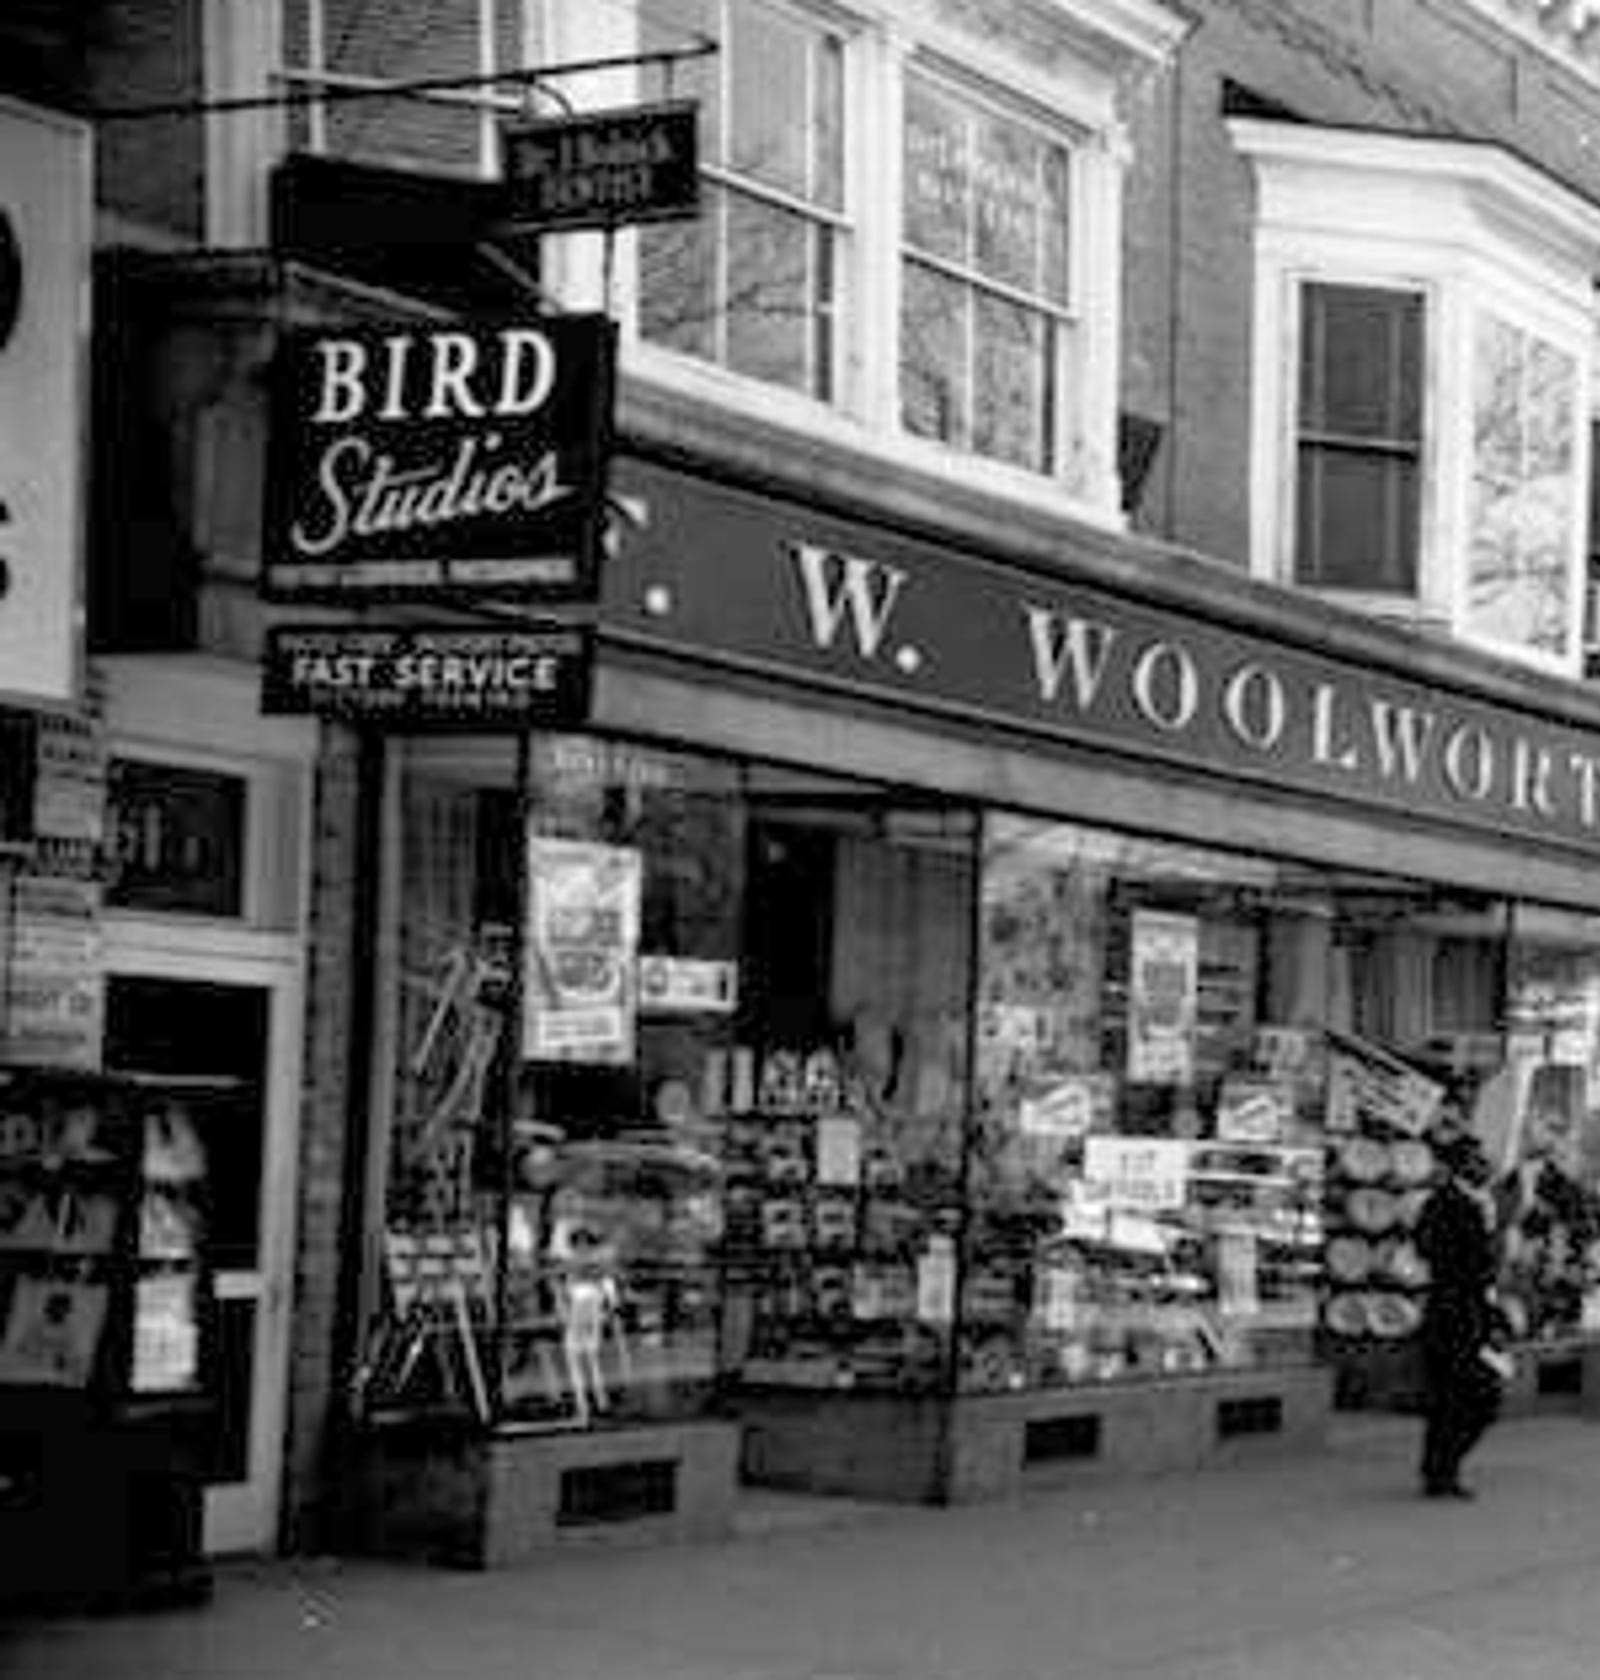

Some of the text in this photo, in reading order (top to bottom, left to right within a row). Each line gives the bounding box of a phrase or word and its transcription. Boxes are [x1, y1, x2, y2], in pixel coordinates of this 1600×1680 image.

[311, 329, 556, 423] BIRD
[291, 433, 577, 555] Studios
[788, 540, 921, 674] W.
[293, 656, 556, 690] FAST SERVICE
